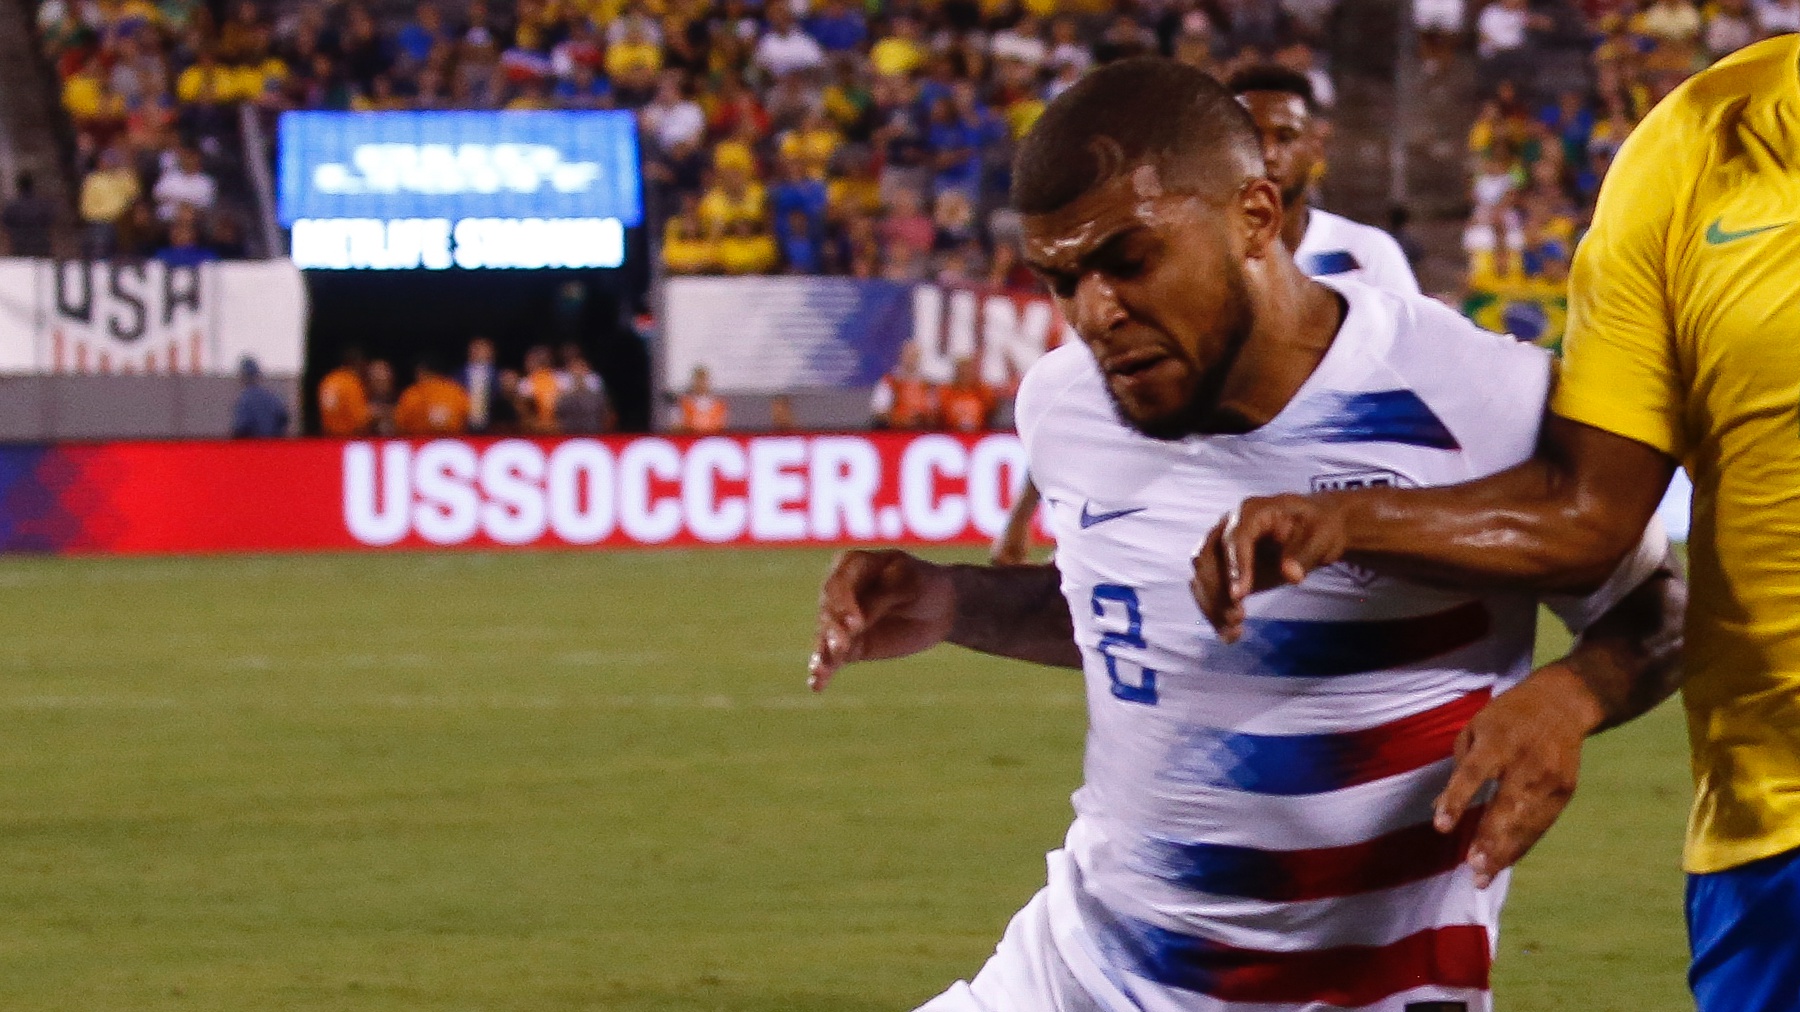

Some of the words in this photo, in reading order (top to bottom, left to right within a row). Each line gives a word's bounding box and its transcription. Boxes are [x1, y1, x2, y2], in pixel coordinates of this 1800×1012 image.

[55, 258, 202, 342] USA
[342, 434, 1056, 545] USSOCCER.CO
[1091, 583, 1159, 706] 2
